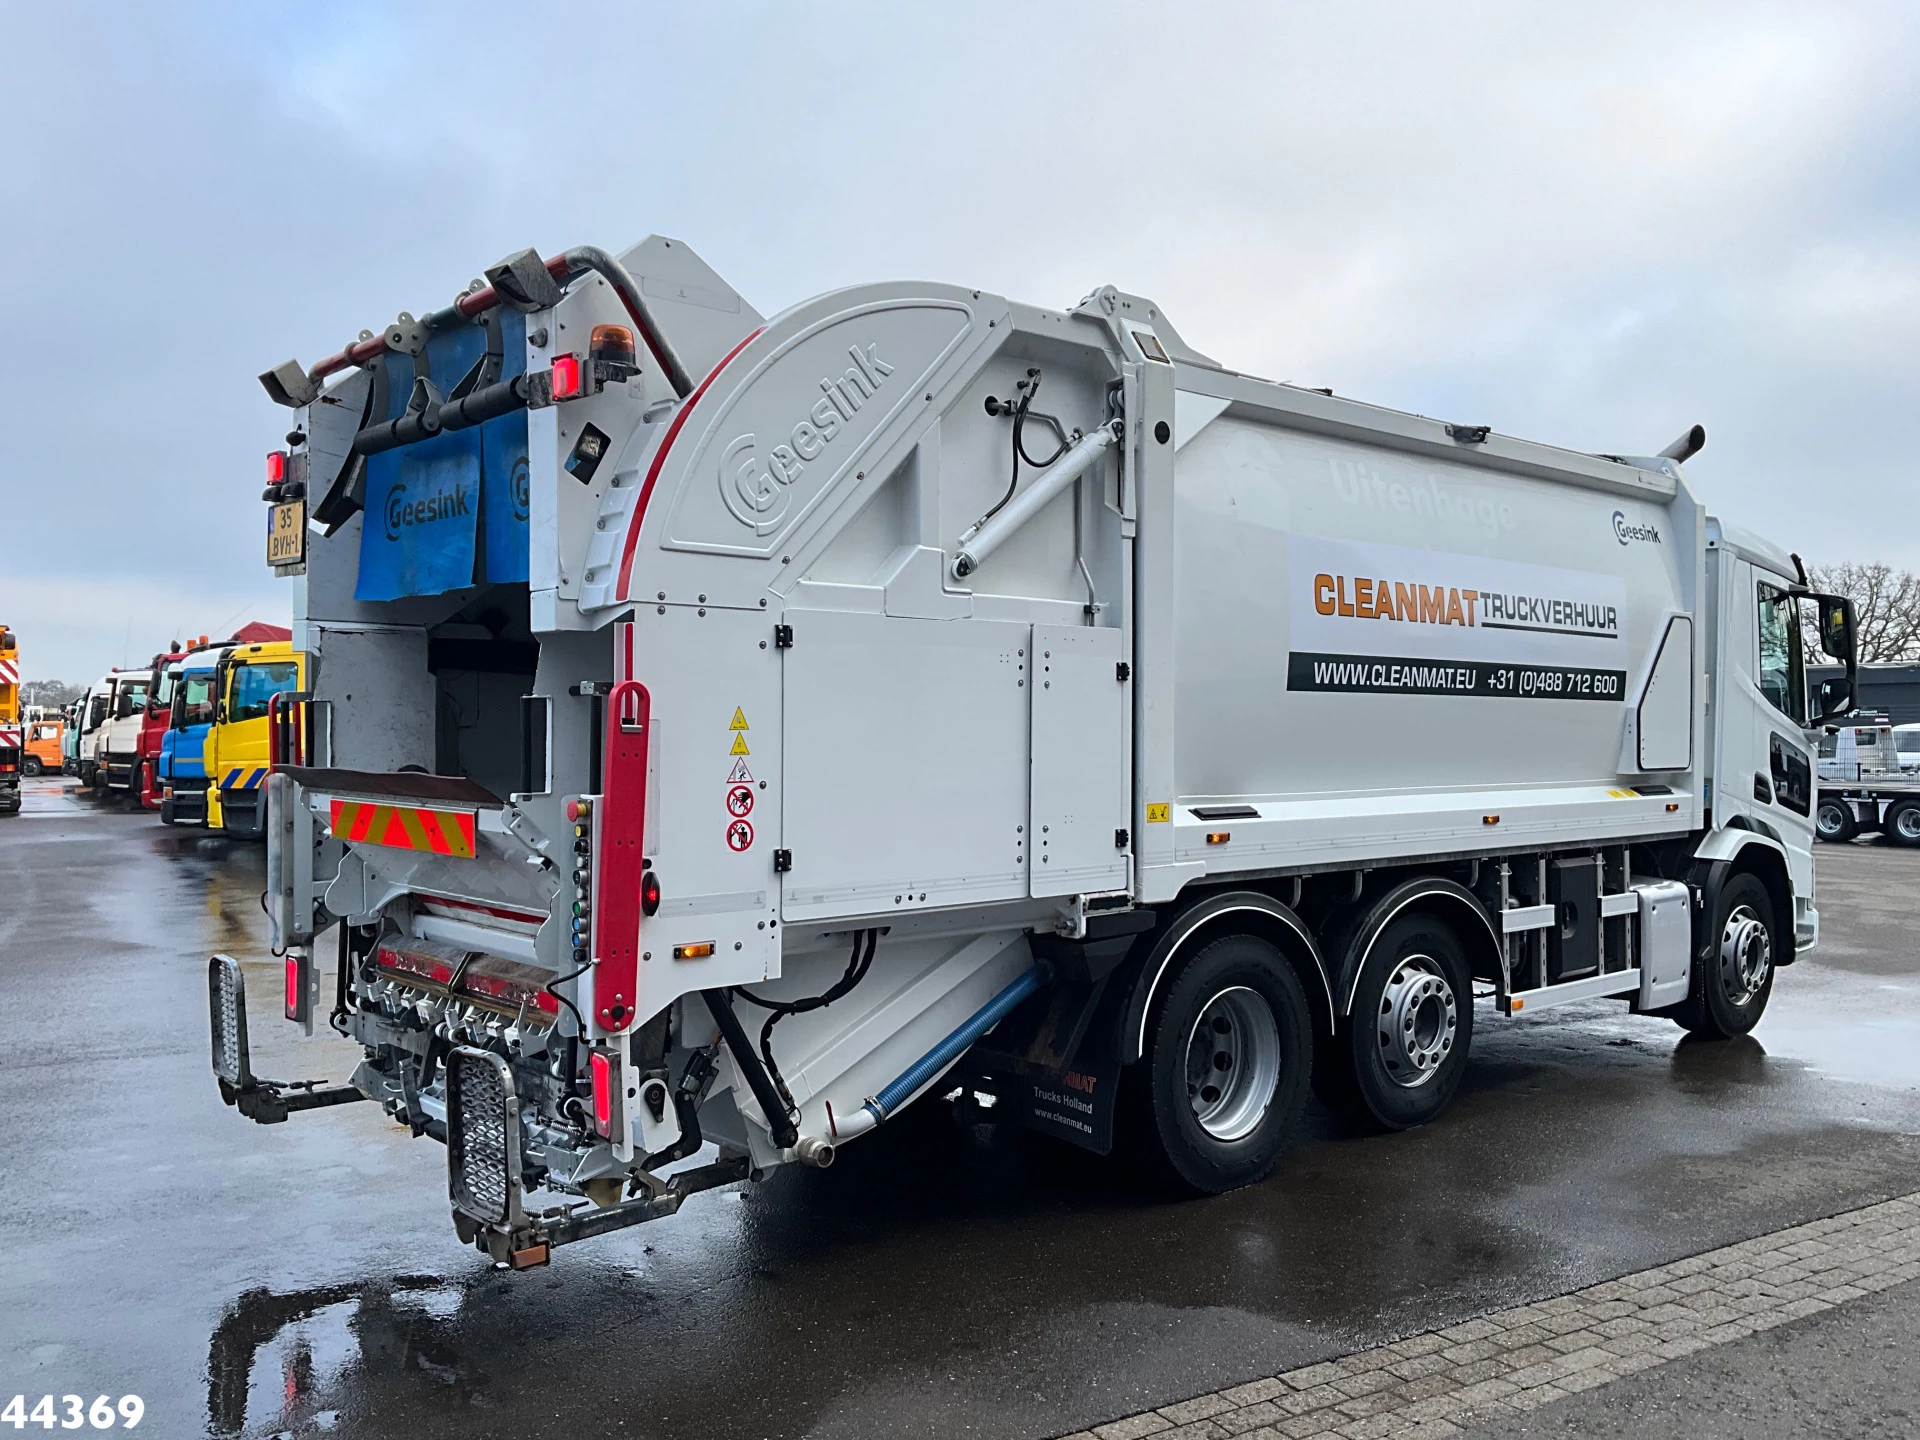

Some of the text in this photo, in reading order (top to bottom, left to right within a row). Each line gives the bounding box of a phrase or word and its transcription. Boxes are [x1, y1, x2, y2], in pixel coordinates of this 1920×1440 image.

[718, 341, 895, 538] Geesink
[384, 484, 470, 542] Geesink
[1328, 458, 1520, 539] Uitenhage
[280, 507, 292, 529] 35
[1612, 510, 1662, 546] Geesink
[272, 533, 298, 557] BVH-1
[1314, 573, 1617, 630] CLEANMAT TRUCKVERHUUR
[1313, 661, 1618, 695] WWW.CLEANMAT.EU +31 (0)488 712 600
[1033, 1086, 1093, 1115] Trucks Holland
[1034, 1108, 1092, 1134] www.cleanmat.eu
